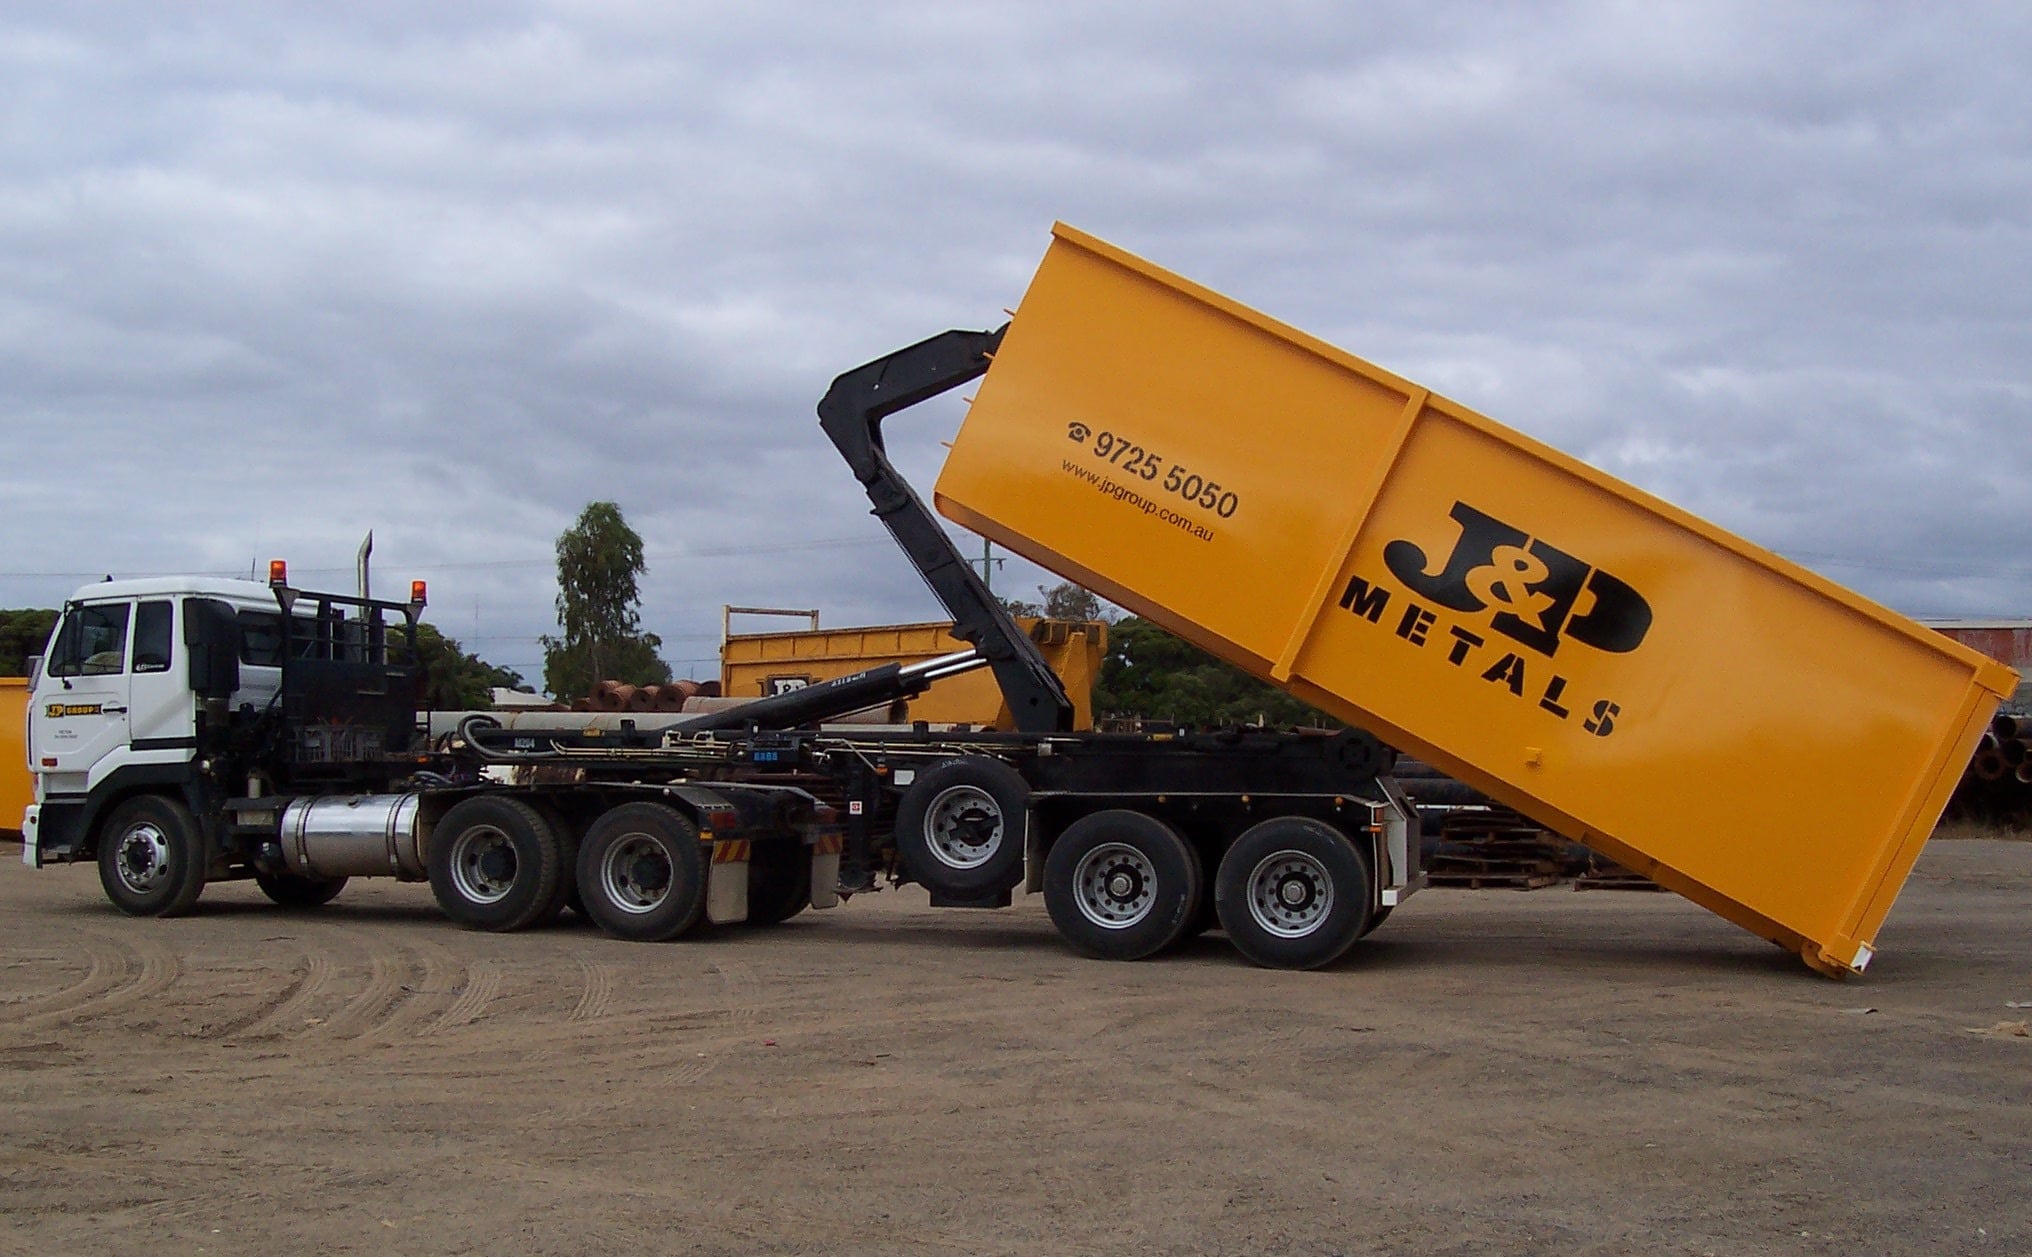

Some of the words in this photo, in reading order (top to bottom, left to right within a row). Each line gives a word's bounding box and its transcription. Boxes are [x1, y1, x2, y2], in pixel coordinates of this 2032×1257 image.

[1062, 459, 1214, 542] www.jpgroup.com.au
[1093, 431, 1162, 481] 9725
[1163, 465, 1239, 519] 5050
[1383, 500, 1653, 659] J&P
[1338, 575, 1621, 737] METALS
